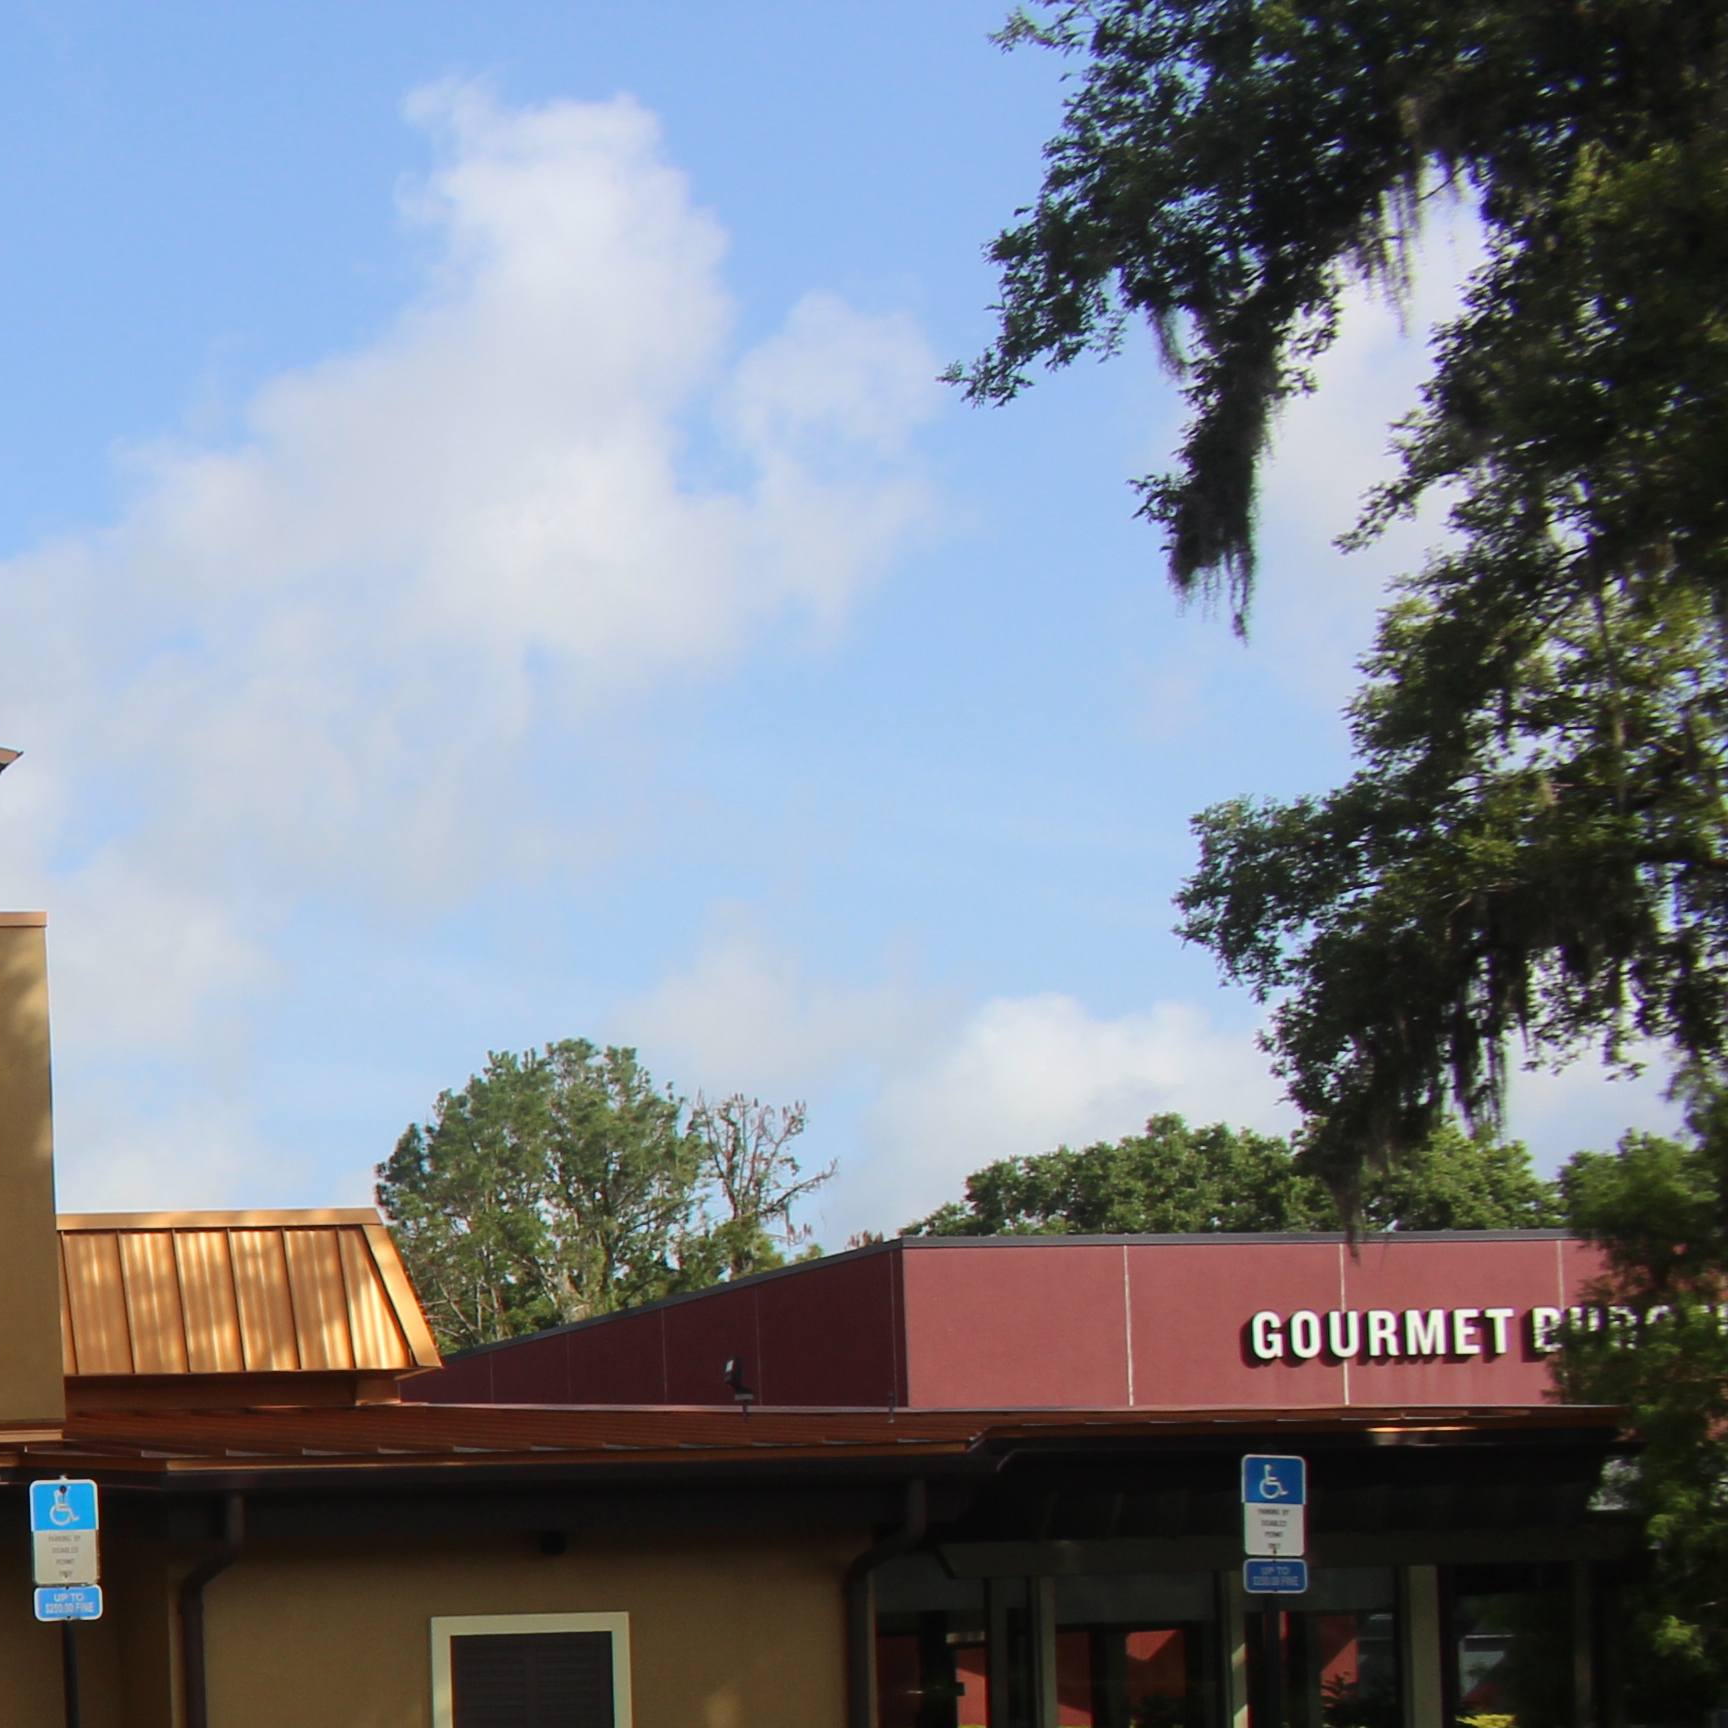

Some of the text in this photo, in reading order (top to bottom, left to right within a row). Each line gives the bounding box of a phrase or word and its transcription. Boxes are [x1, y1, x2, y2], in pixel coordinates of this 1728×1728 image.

[1251, 1307, 1515, 1360] GOURMET
[53, 1593, 84, 1602] UP TO
[75, 1602, 95, 1613] FINE
